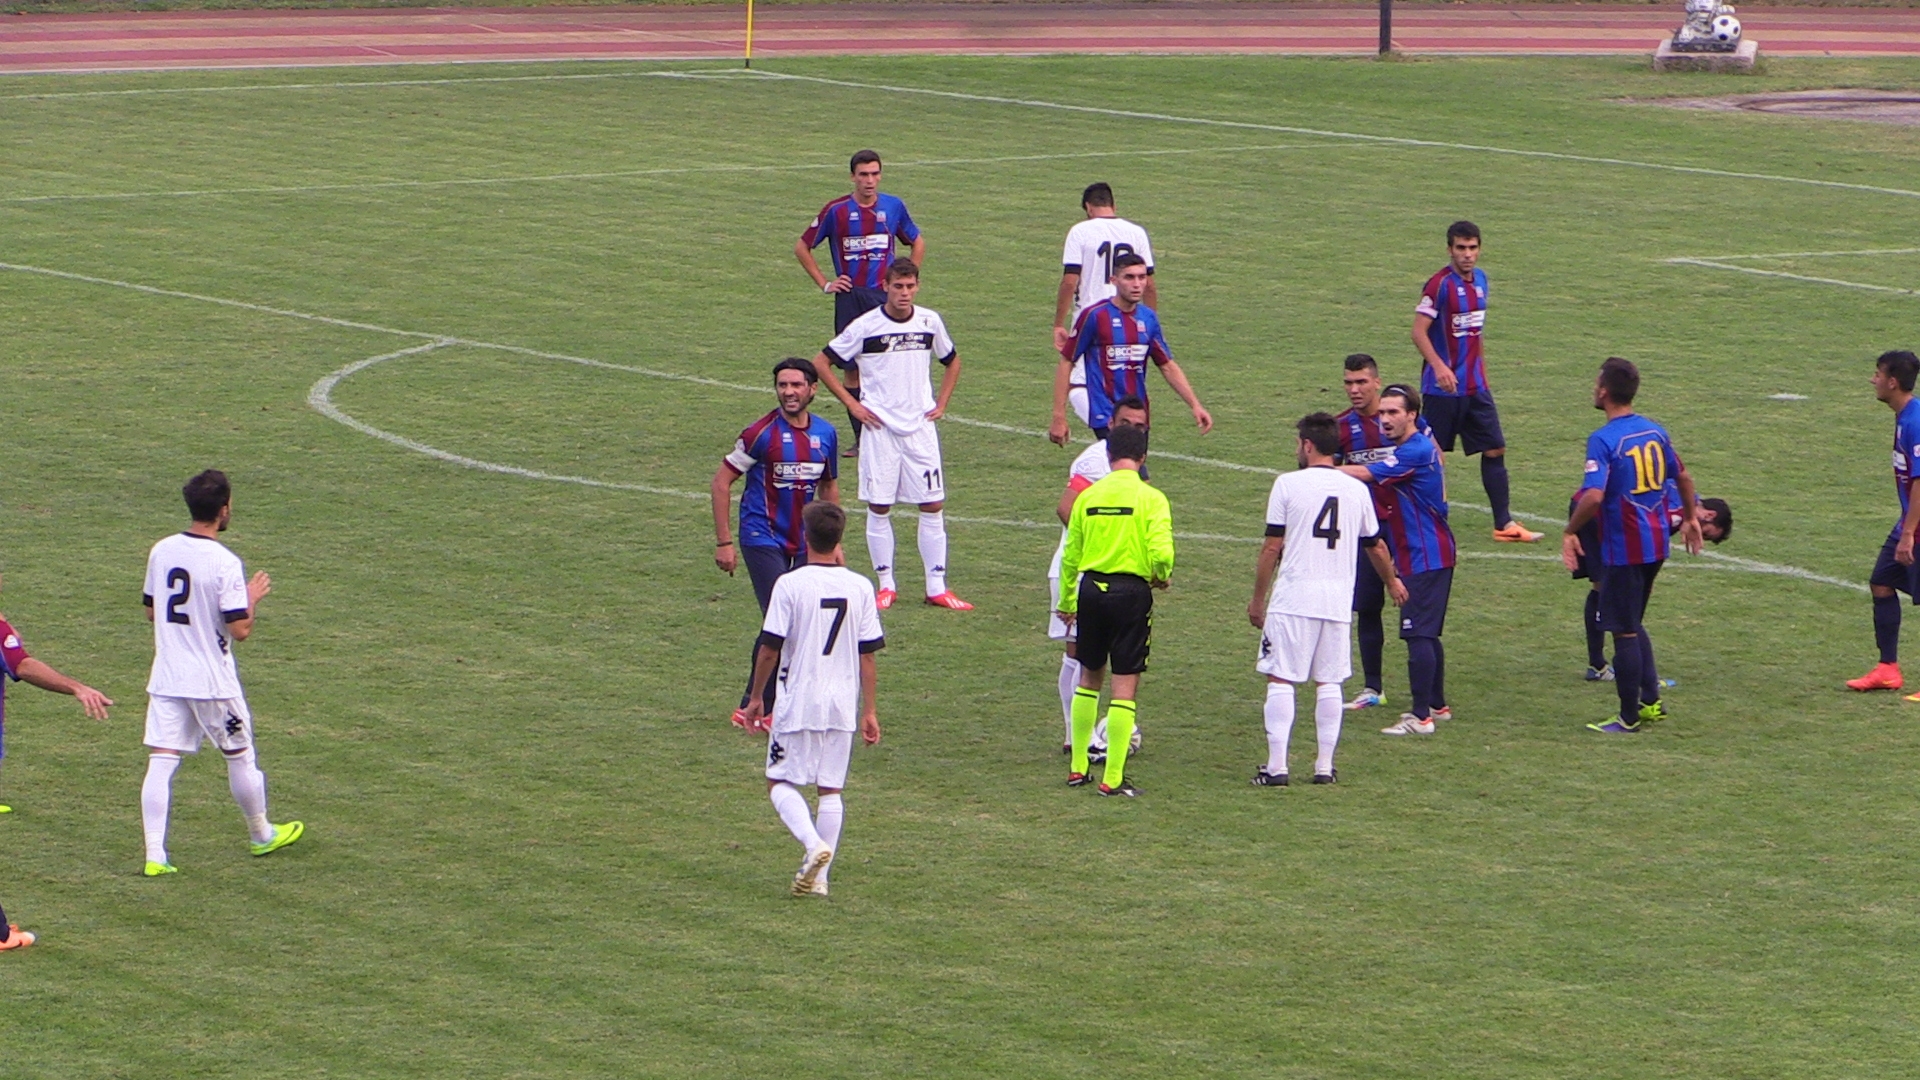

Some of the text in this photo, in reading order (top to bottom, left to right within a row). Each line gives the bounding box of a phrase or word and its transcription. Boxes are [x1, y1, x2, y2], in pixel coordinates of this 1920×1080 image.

[923, 468, 941, 490] 11
[1625, 440, 1665, 494] 10
[1313, 496, 1340, 550] 4
[167, 567, 191, 626] 2
[820, 598, 847, 656] 7
